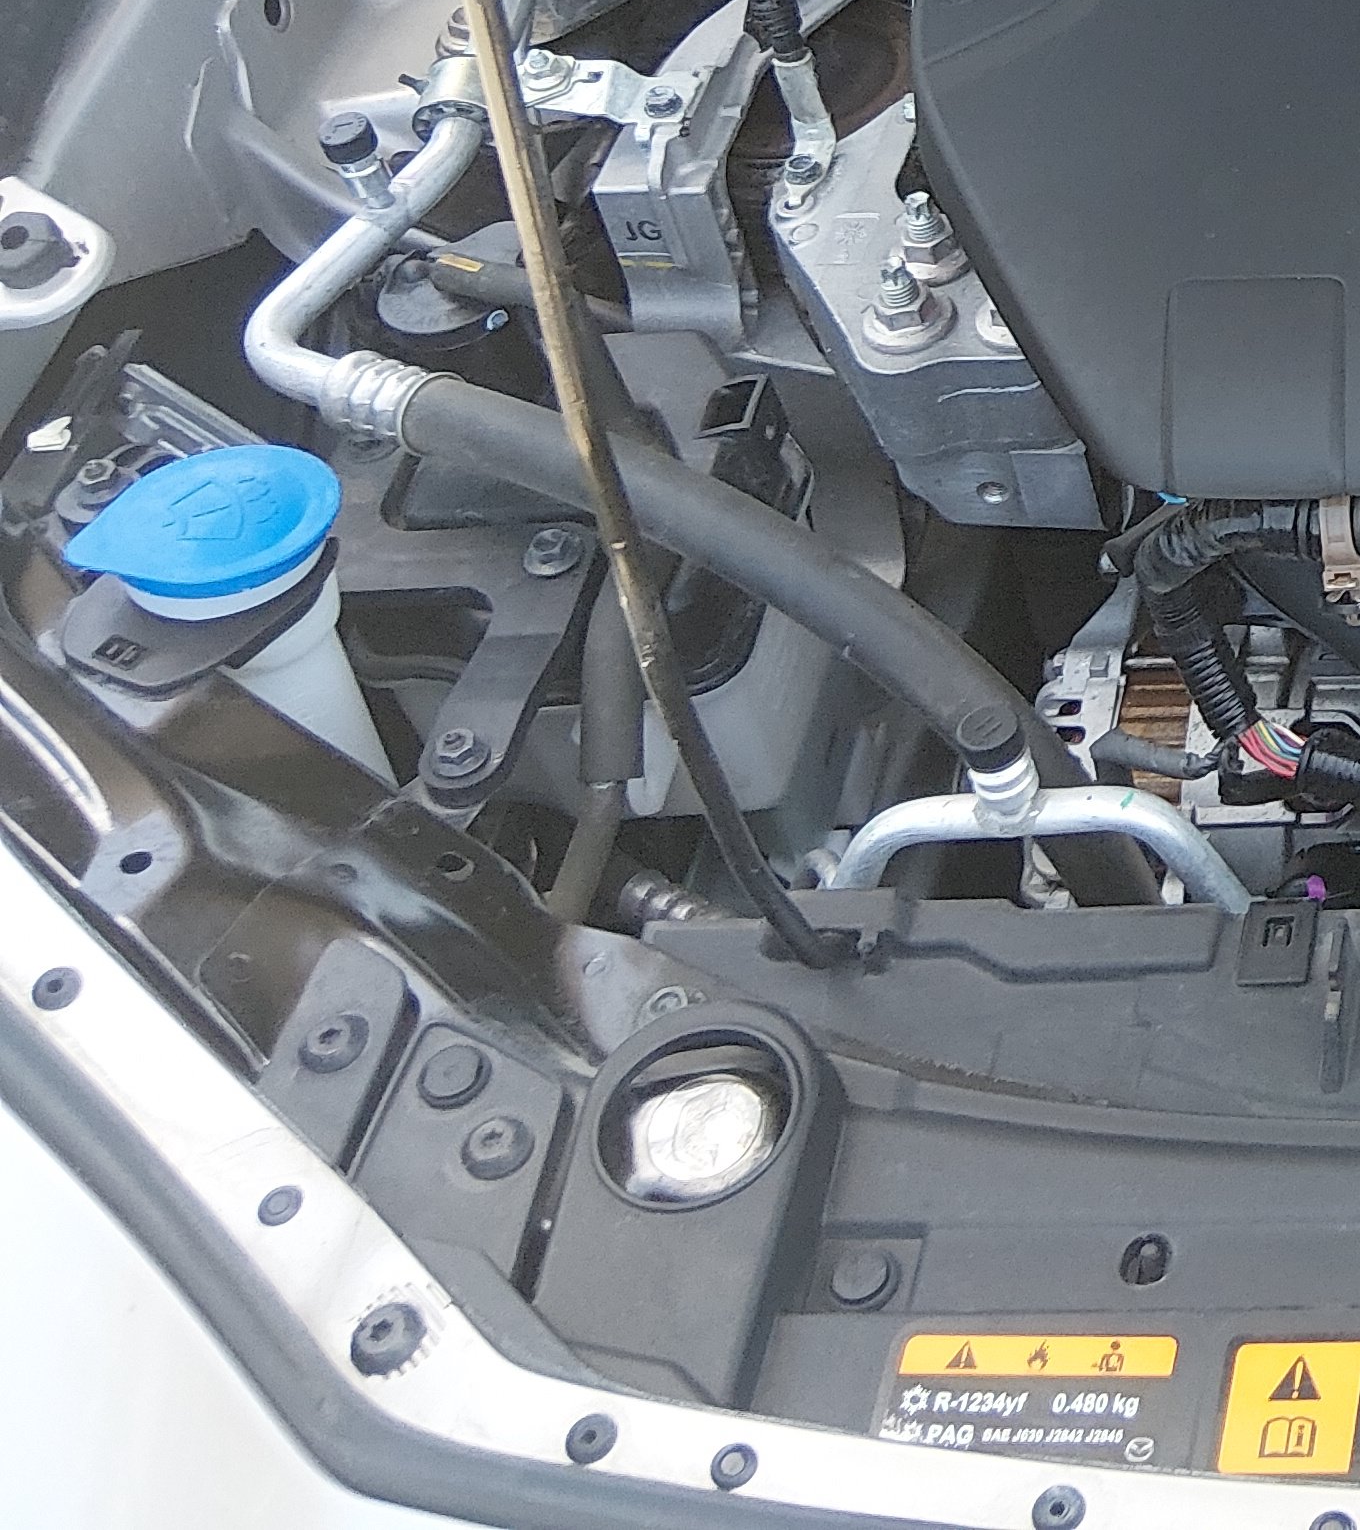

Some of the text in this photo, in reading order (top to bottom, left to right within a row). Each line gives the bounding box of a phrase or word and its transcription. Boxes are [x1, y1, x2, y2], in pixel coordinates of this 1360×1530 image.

[626, 220, 663, 241] JG
[932, 1390, 1141, 1419] R-1234yf 0.480 kg
[923, 1423, 975, 1447] PAG
